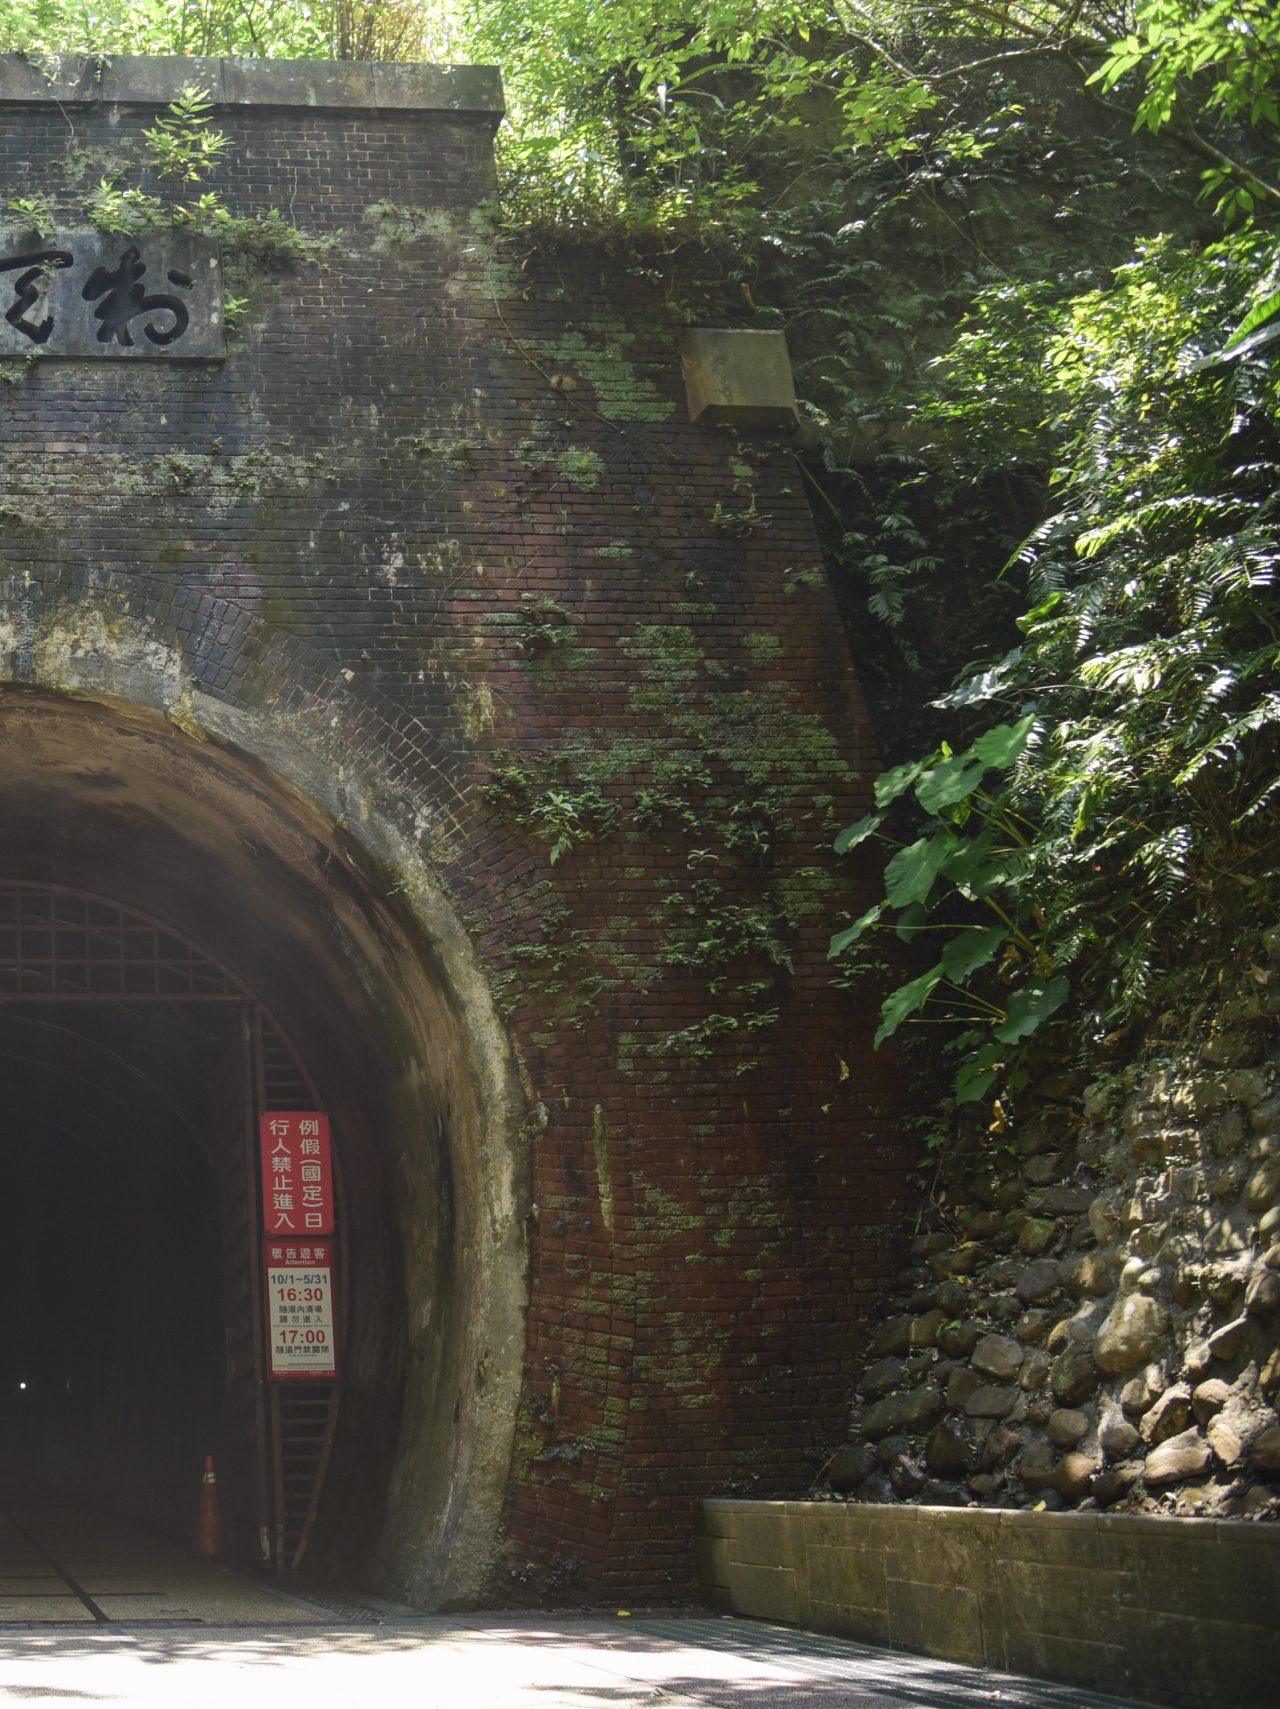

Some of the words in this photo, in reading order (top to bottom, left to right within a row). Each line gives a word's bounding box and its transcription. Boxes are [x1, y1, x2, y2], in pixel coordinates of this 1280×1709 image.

[270, 1120, 295, 1228] 行人禁止進入
[271, 1248, 325, 1259] 敬告遊客
[271, 1274, 328, 1284] 10/1~5/31
[277, 1288, 323, 1301] 16:30
[279, 1330, 325, 1344] 17:00
